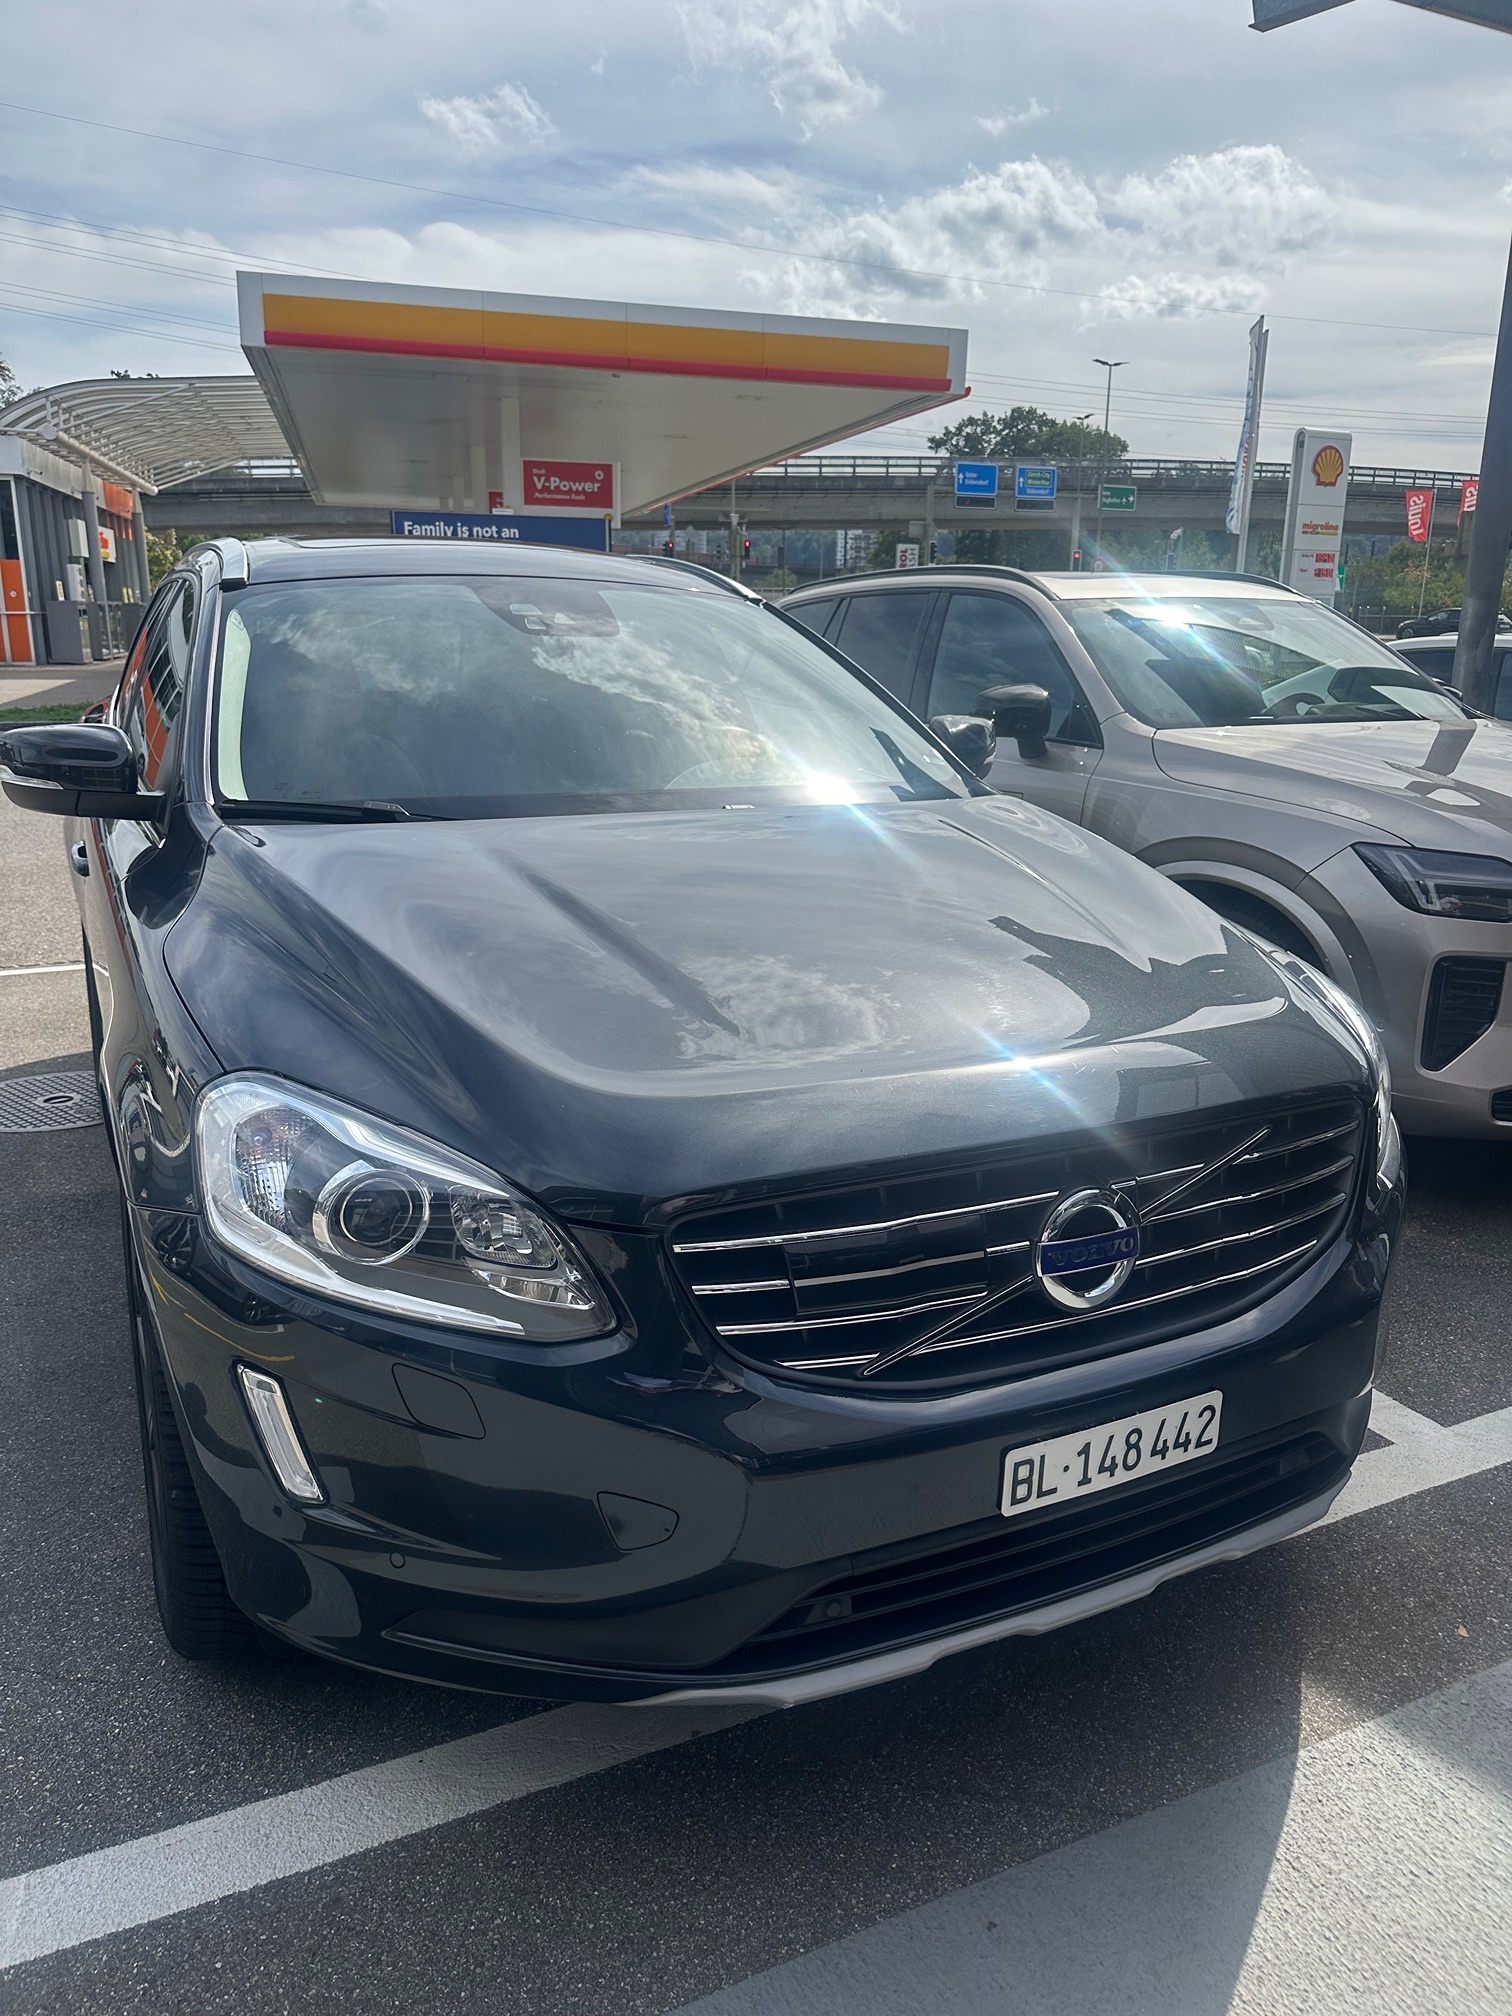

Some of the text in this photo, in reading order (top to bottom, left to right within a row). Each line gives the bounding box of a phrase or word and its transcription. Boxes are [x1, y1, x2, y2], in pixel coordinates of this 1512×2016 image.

[533, 476, 601, 492] V-Power
[403, 521, 520, 538] Family is not an
[1302, 521, 1339, 532] migrolino
[1047, 1237, 1135, 1266] VOLVO
